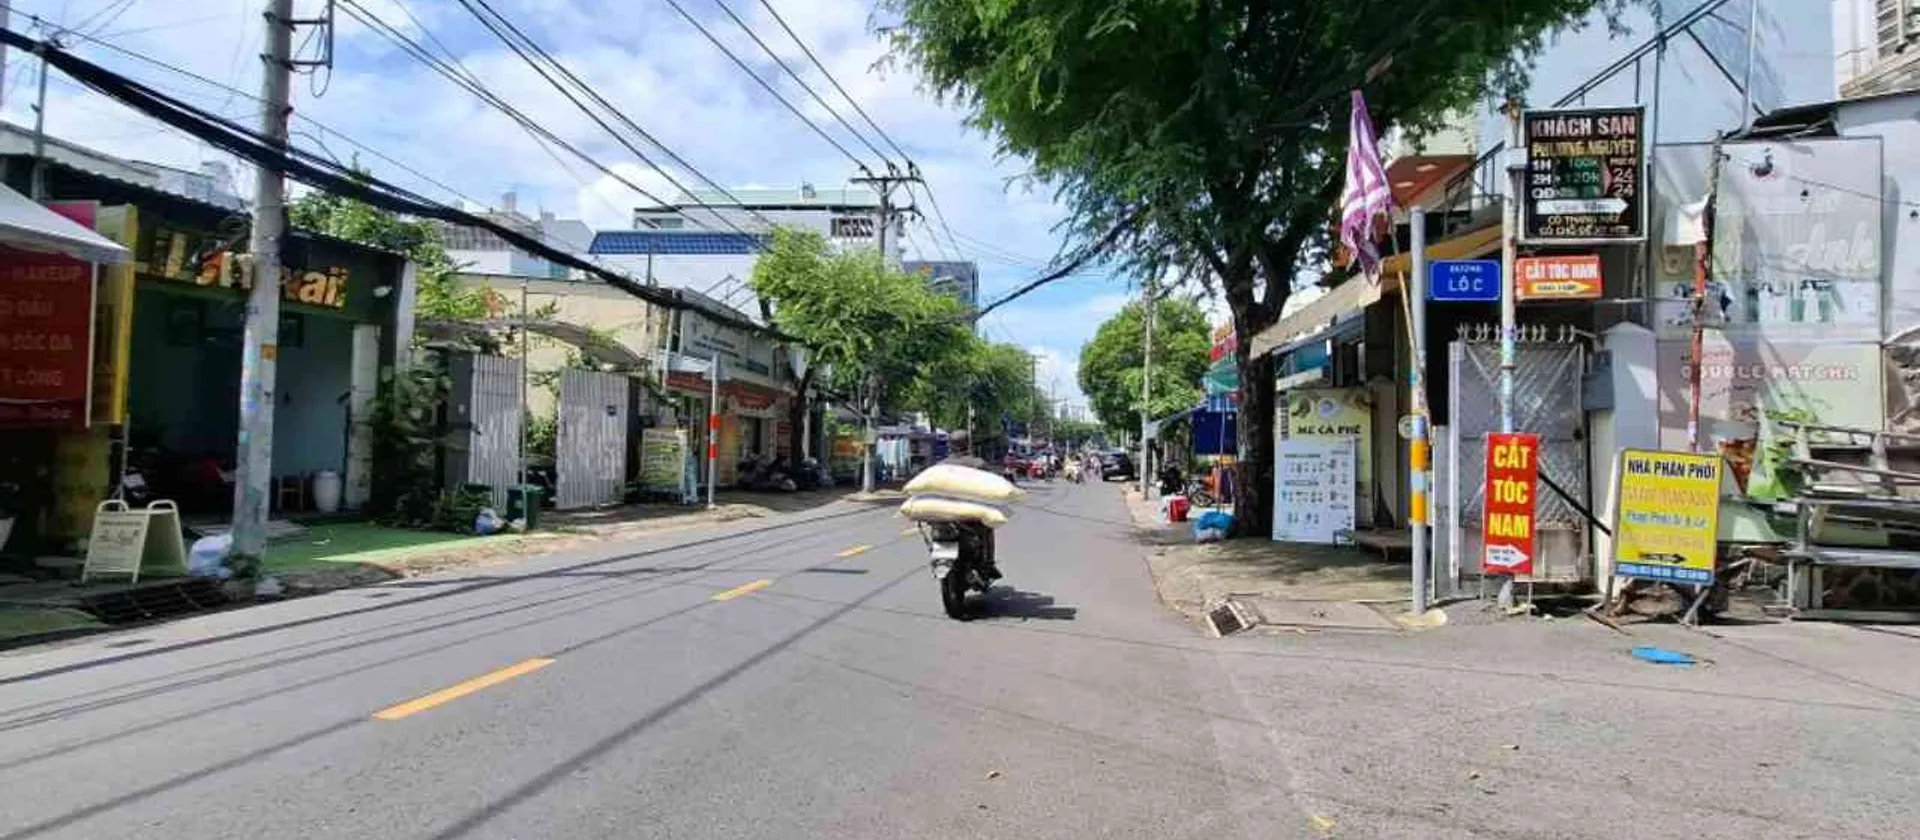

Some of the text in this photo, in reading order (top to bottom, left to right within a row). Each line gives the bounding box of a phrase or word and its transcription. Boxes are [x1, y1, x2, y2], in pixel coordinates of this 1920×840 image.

[1531, 115, 1636, 138] KHÁCH SẠN
[1494, 436, 1530, 469] CẮT
[1494, 475, 1529, 504] TÓC
[1489, 512, 1530, 538] NAM
